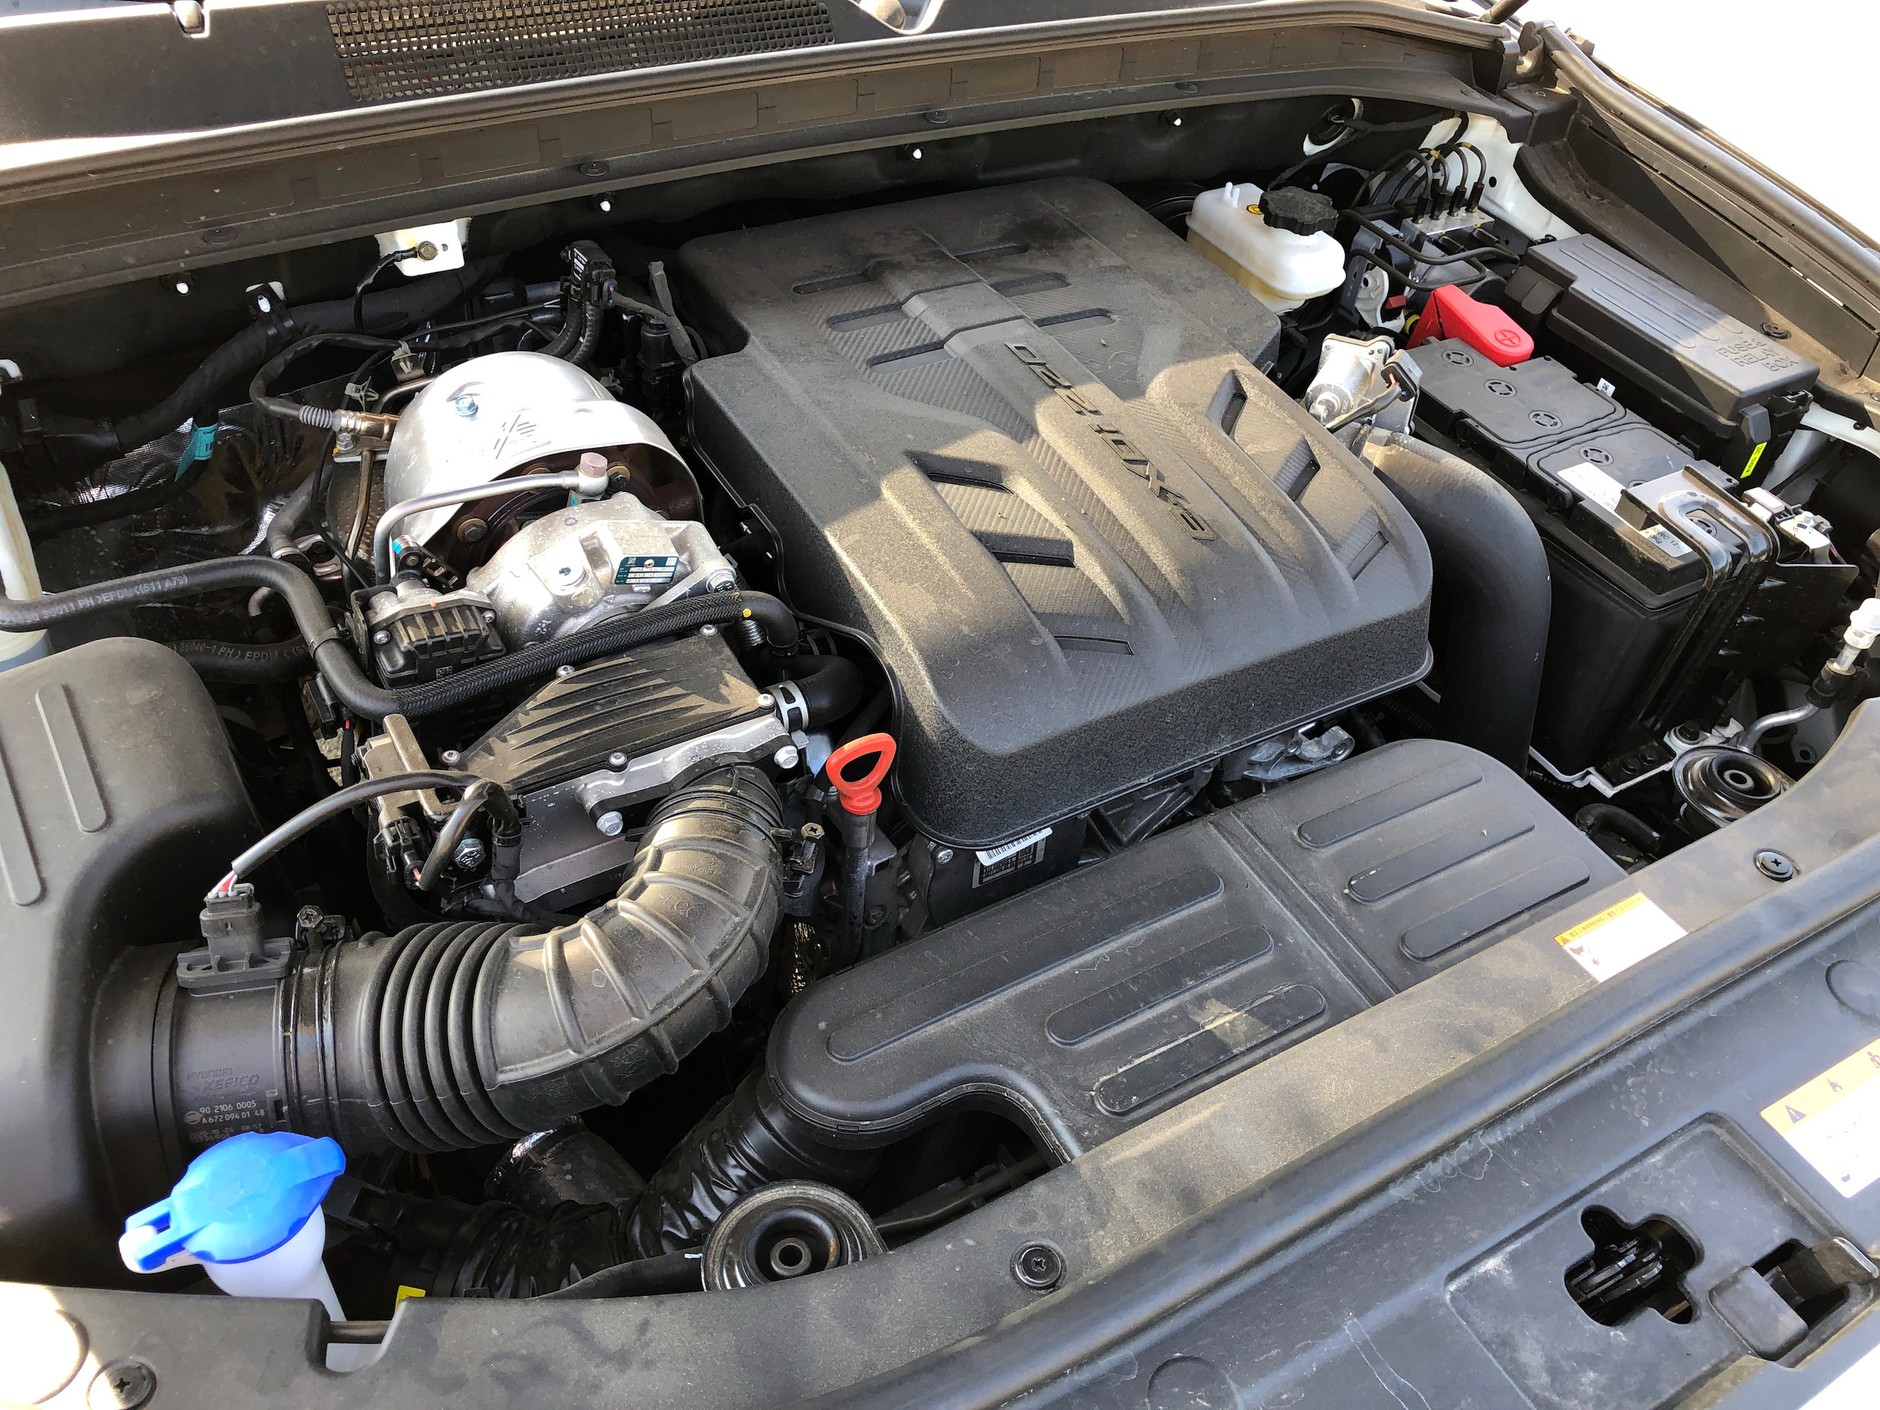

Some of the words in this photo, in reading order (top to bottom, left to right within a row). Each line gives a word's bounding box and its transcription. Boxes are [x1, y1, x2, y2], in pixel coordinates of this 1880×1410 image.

[1730, 348, 1780, 367] RELAY
[1761, 356, 1799, 372] BOX
[204, 1073, 259, 1091] KEFICO
[200, 1106, 211, 1115] 90
[214, 1103, 233, 1113] 2106
[236, 1099, 257, 1110] 0005
[254, 1108, 265, 1117] 48
